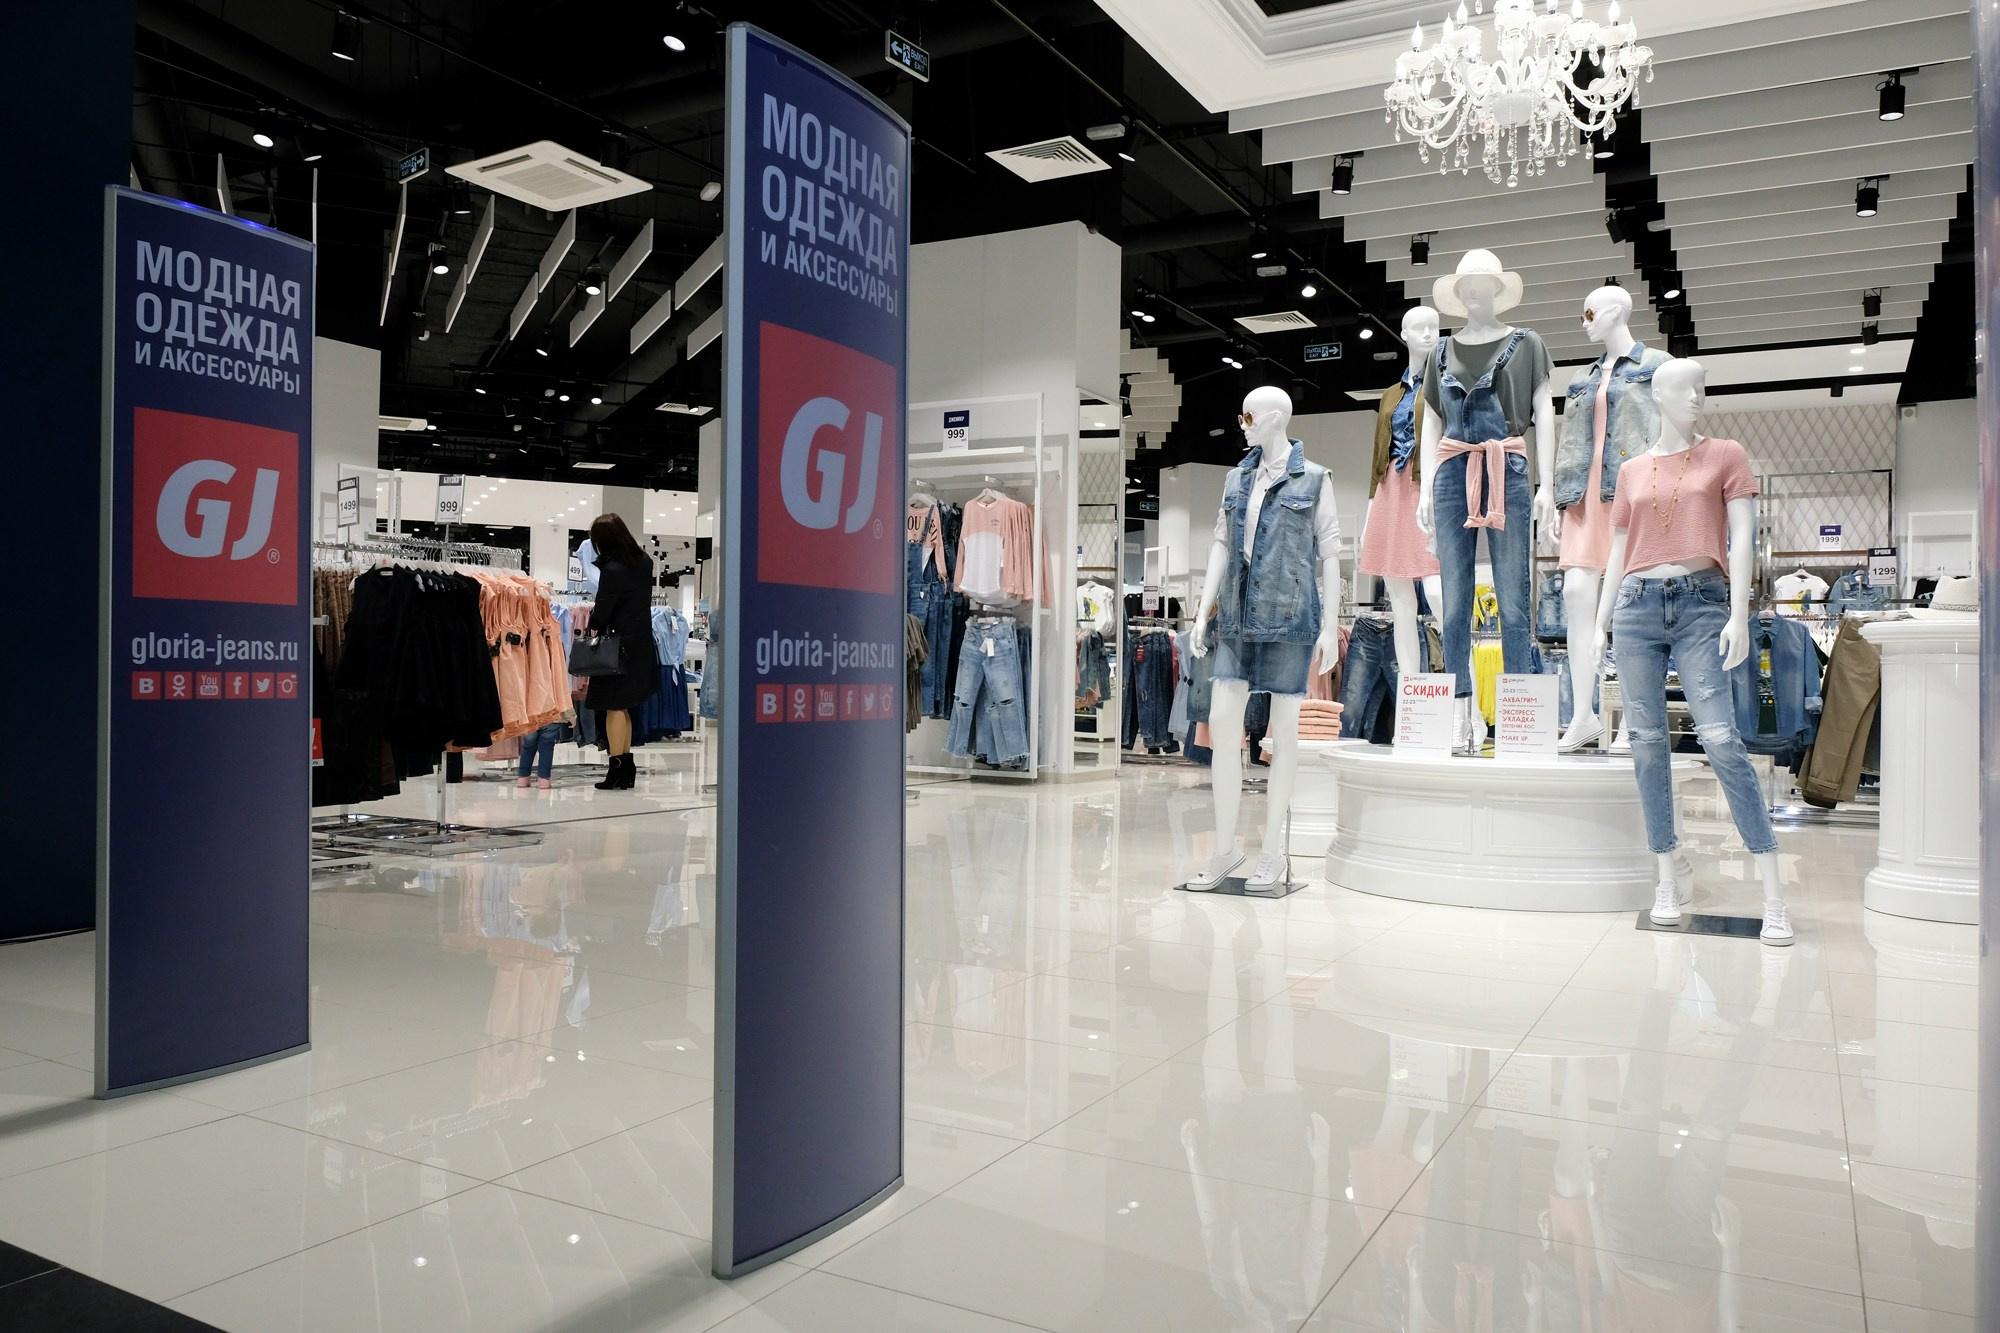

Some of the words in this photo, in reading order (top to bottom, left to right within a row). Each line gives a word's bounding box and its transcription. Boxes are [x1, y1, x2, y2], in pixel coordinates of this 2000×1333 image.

[911, 49, 927, 67] ВЫХОД
[915, 61, 924, 72] EXIT
[763, 92, 899, 217] МОДНАЯ
[762, 165, 898, 276] ОДЕЖДА
[136, 239, 300, 320] МОДНАЯ
[761, 230, 776, 266] И
[783, 240, 898, 317] АКСЕССУАРЫ
[136, 292, 300, 366] ОДЕЖДА
[135, 340, 151, 366] И
[159, 345, 300, 395] АКСЕССУАРЫ
[947, 428, 965, 439] 999
[340, 500, 356, 511] 1499
[440, 501, 458, 512] 999
[570, 566, 581, 575] 499
[1872, 567, 1896, 576] 1299
[131, 631, 298, 666] gloria-jeans.ru
[756, 630, 895, 675] gloria-jeans.ru
[1403, 684, 1449, 698] СКИДКИ
